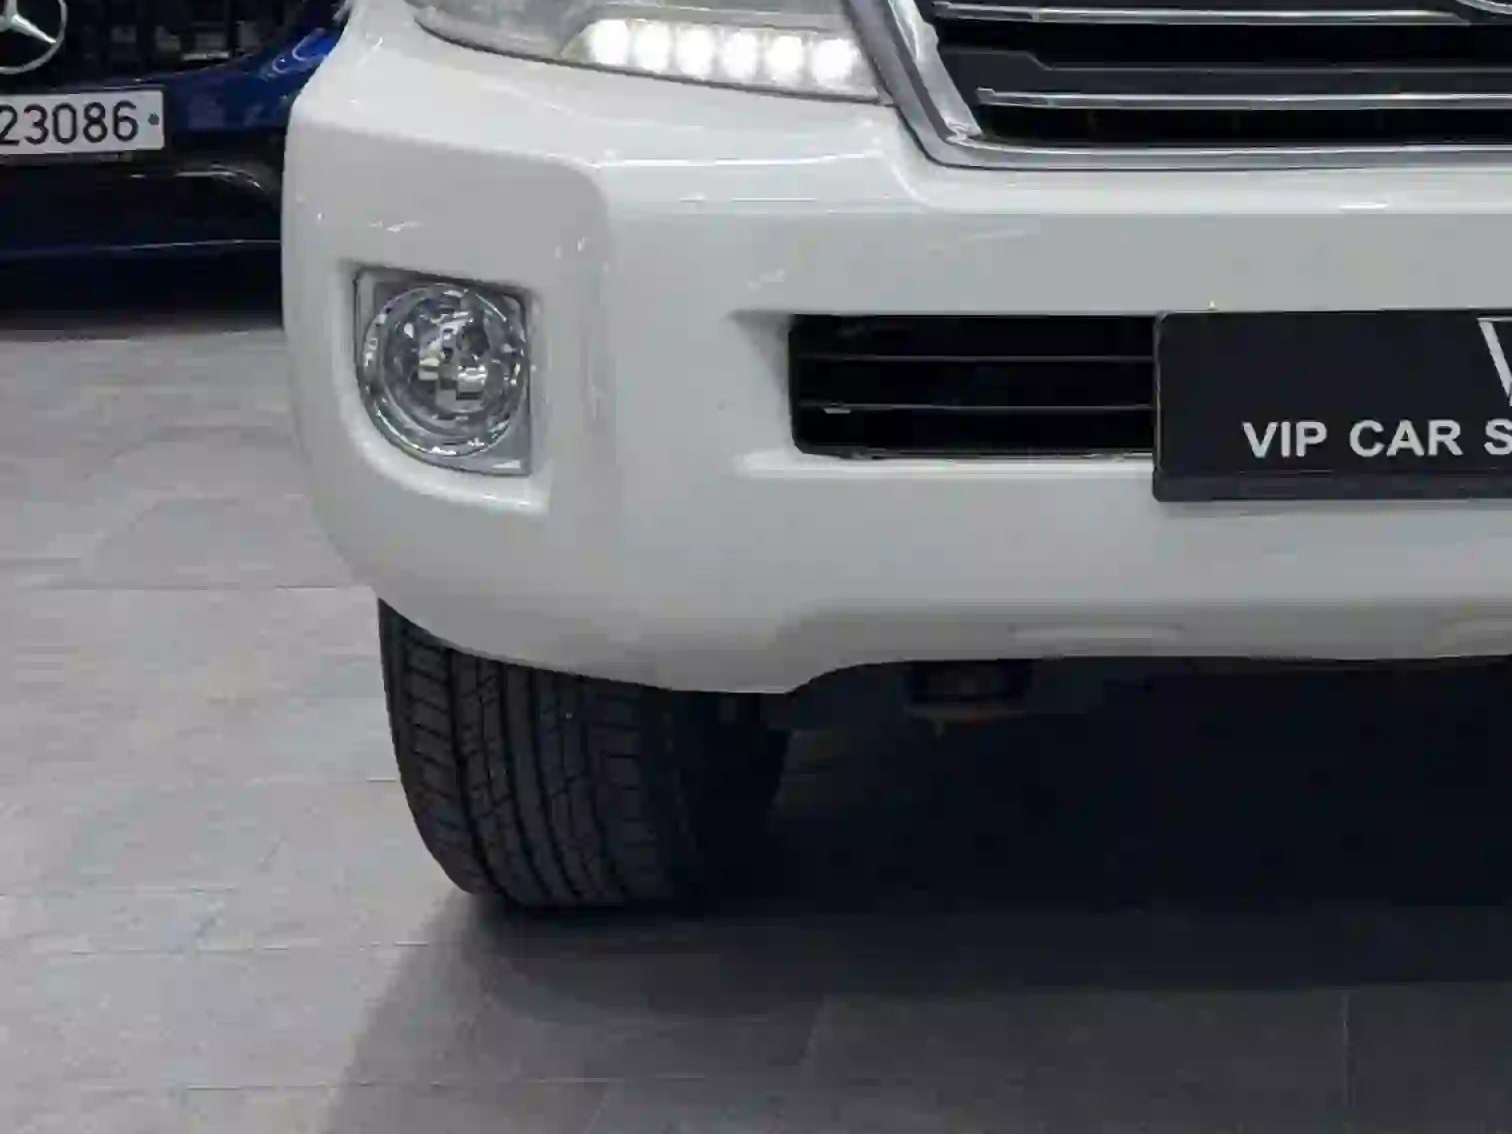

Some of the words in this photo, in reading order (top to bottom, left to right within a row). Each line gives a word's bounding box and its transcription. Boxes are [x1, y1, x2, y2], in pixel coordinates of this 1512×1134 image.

[0, 99, 139, 146] 23086
[1242, 421, 1328, 459] VIP
[1349, 419, 1463, 458] CAR
